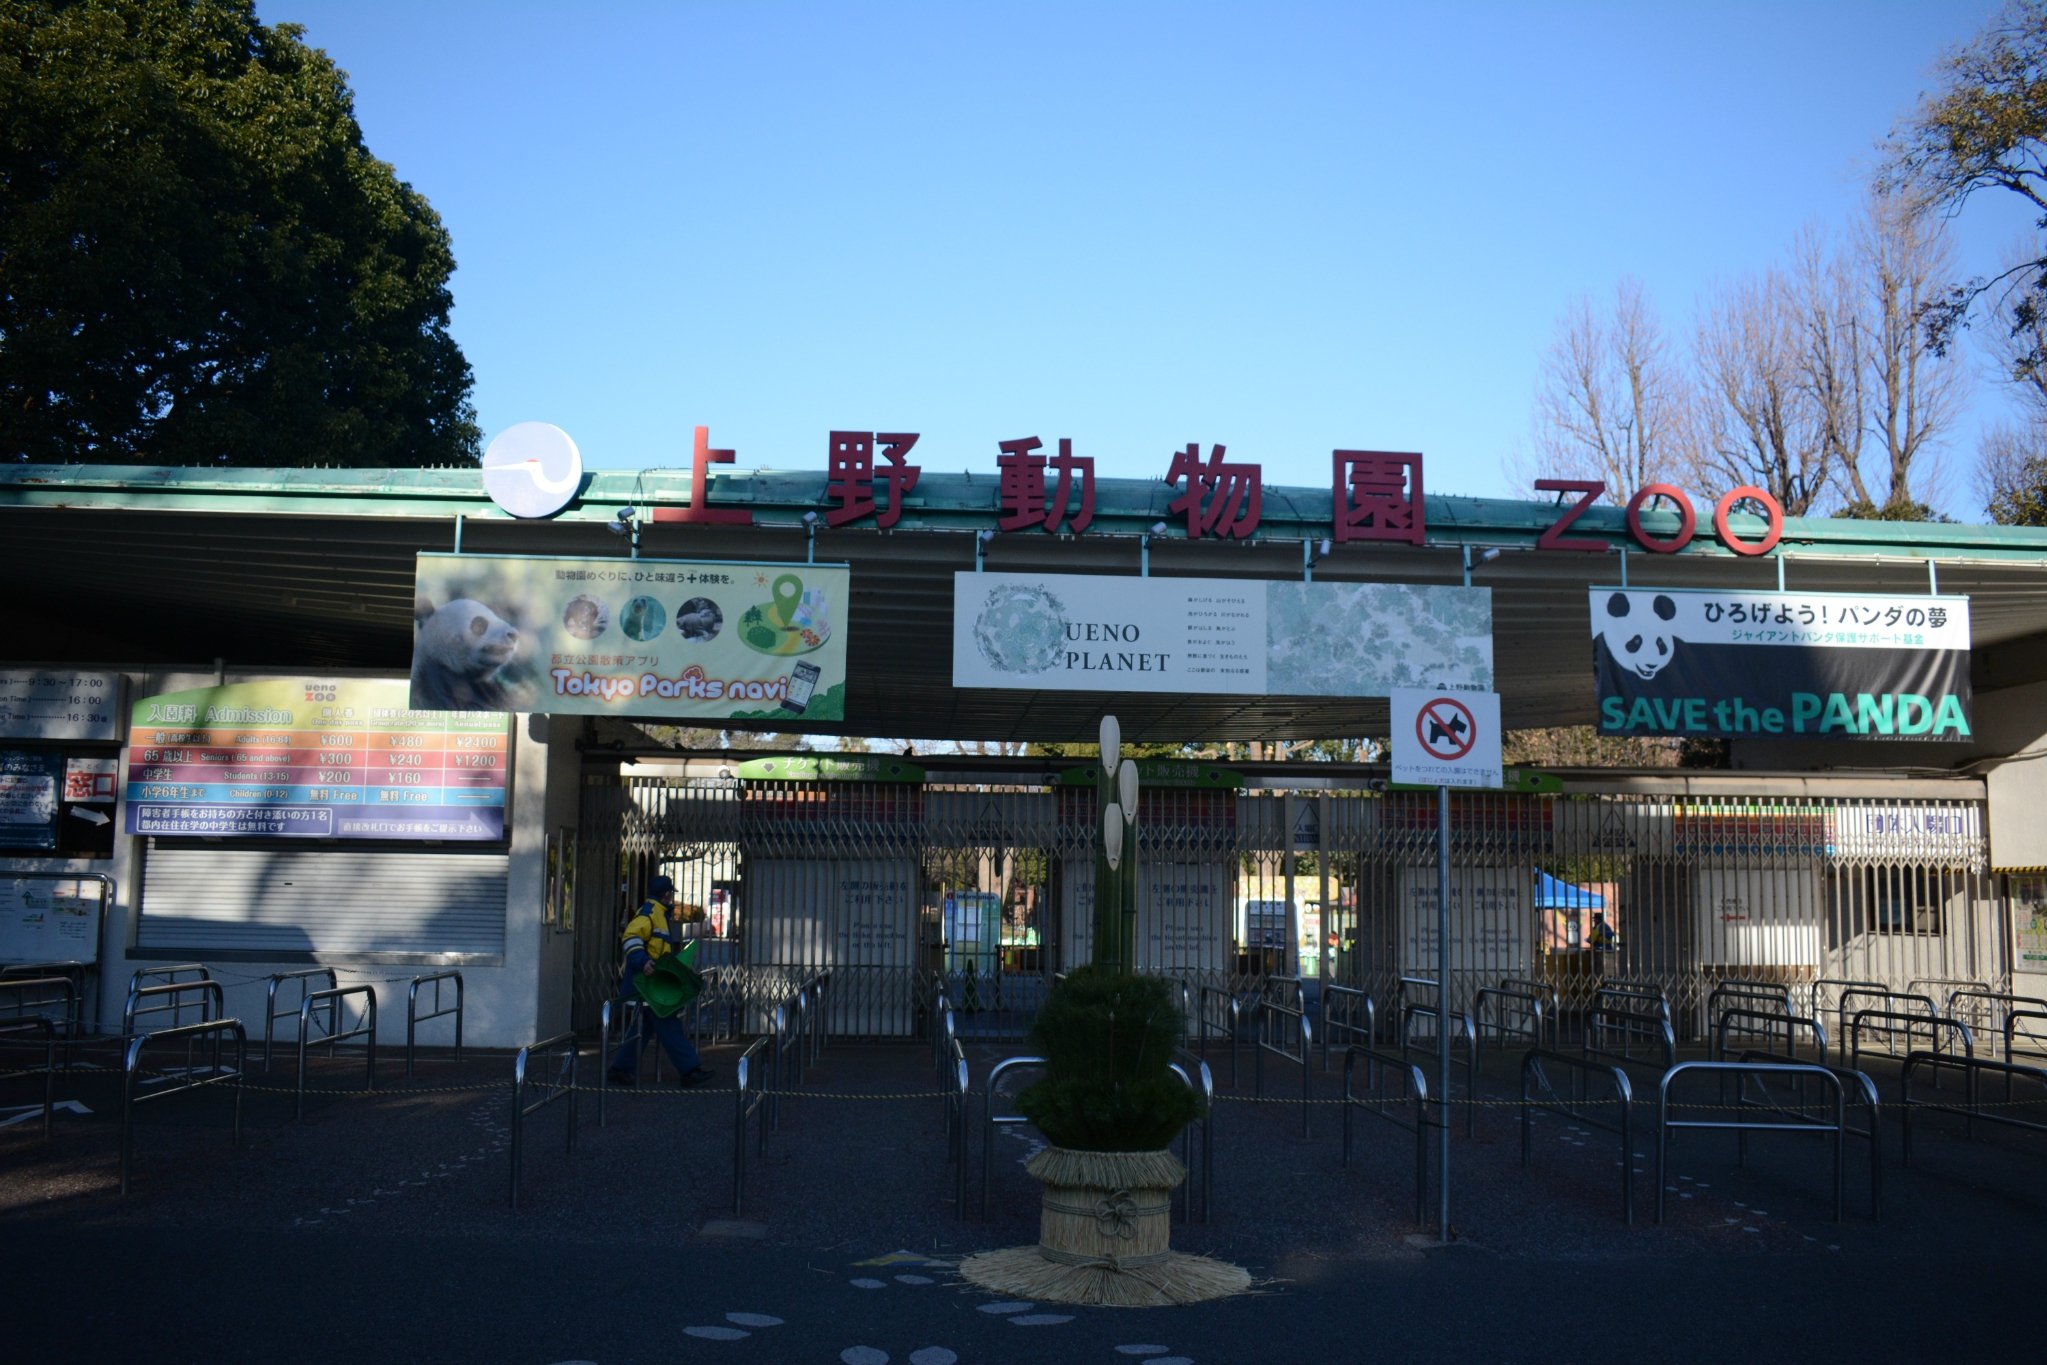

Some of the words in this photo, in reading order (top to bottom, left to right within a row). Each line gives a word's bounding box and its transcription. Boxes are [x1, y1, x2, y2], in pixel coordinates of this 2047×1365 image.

[652, 425, 1426, 546] 上野動物園
[1534, 479, 1784, 556] ZOO
[1064, 622, 1140, 642] UENO
[1732, 629, 1925, 645] ジャイアントパンダ保護サポート基金
[551, 653, 659, 667] 都立公園散策アプリ
[1065, 651, 1170, 672] PLANET
[305, 684, 337, 692] ueno
[551, 668, 636, 701] Tokyo
[638, 667, 725, 700] Parks
[727, 676, 788, 701] navi
[147, 704, 197, 722] 入園料
[204, 705, 292, 724] Admission
[1602, 696, 1708, 731] SAVE
[1713, 696, 1784, 732] the
[1791, 692, 1972, 735] PANDA
[146, 731, 166, 744] 一般
[235, 735, 260, 744] Adults
[320, 735, 353, 746] ¥600
[390, 736, 423, 747] ¥480
[456, 736, 497, 748] ¥2400
[201, 752, 229, 762] Seniors
[249, 753, 263, 763] and
[265, 753, 290, 763] above)
[319, 753, 352, 765] ¥300
[389, 753, 422, 765] ¥240
[455, 754, 496, 767] ¥1200
[66, 770, 116, 797] 窓口
[143, 768, 173, 780] 中学生
[224, 771, 258, 780] Students
[260, 772, 289, 782] (13-15)
[318, 771, 351, 783] ¥200
[388, 772, 421, 784] ¥160
[229, 789, 262, 798] Children
[263, 790, 288, 799] (0-12)
[309, 789, 329, 801] 無料
[333, 790, 358, 801] Free
[379, 790, 399, 801] 無料
[403, 791, 428, 802] Free
[141, 808, 328, 821] 障害者手帳をお持ちの方と付き添いの方1名
[141, 819, 285, 832] 都内在住在学の中学生は無料です
[343, 822, 482, 834] 直接改札口でお手帳をご提示下さい
